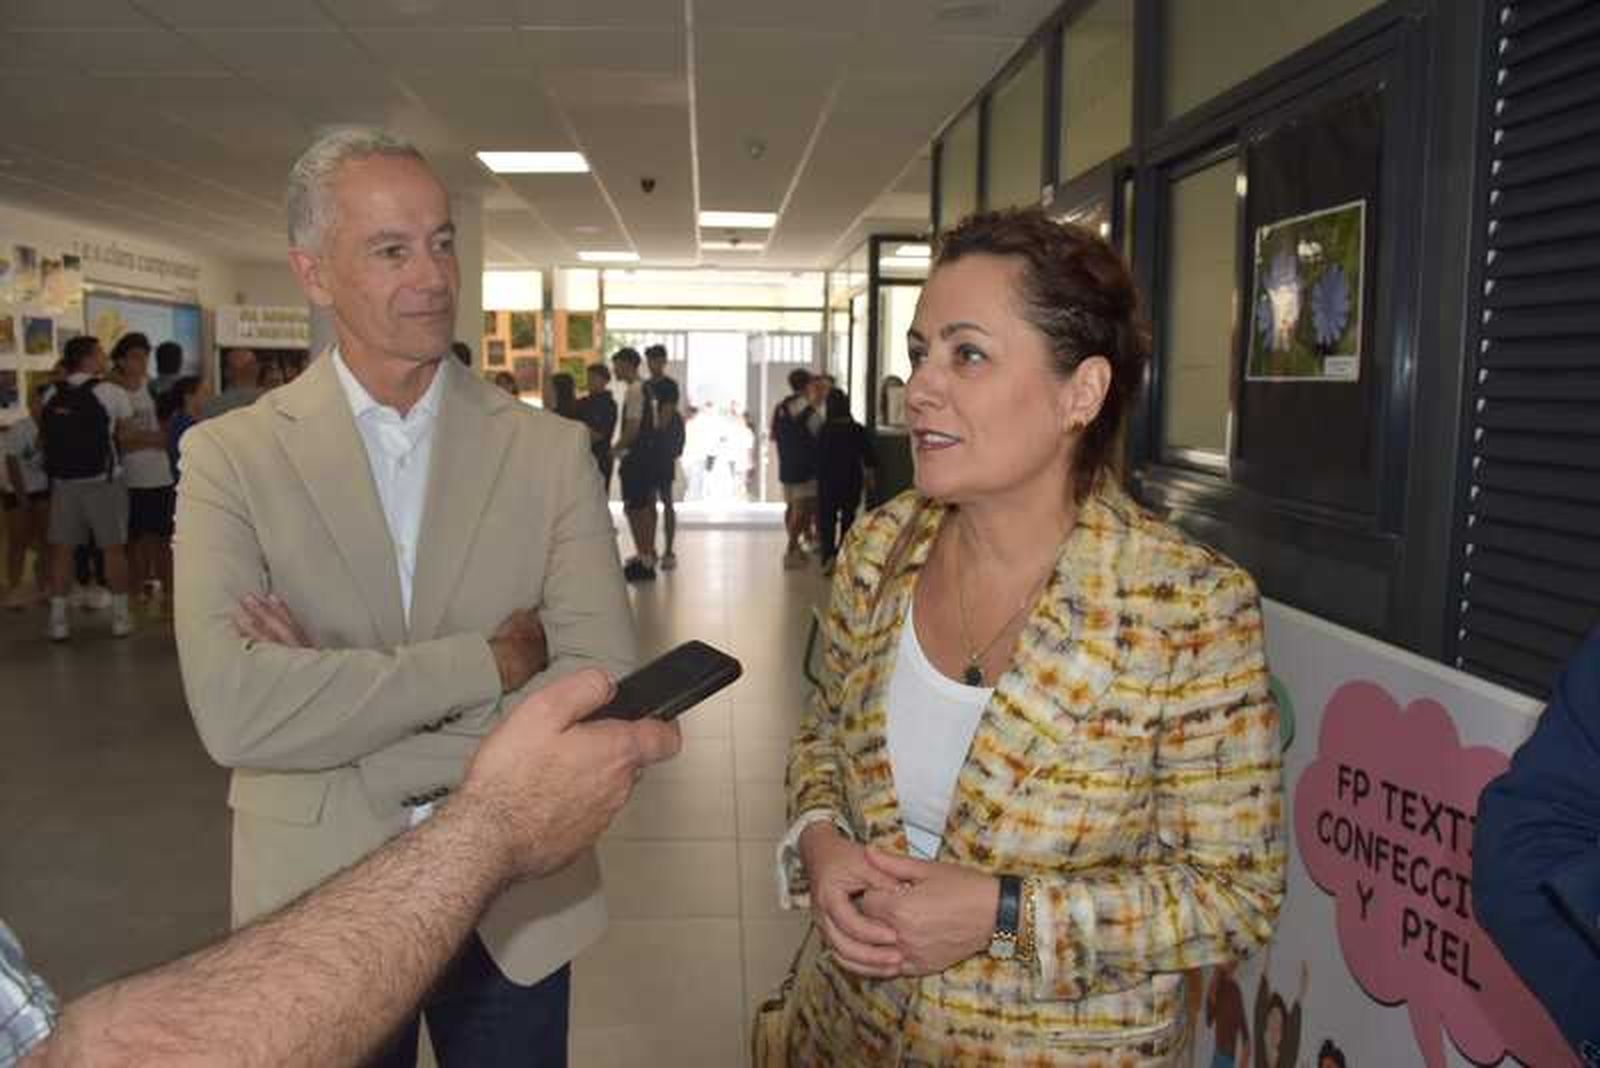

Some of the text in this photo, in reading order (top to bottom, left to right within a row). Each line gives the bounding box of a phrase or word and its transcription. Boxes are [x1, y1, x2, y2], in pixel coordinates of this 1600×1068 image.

[1338, 764, 1371, 807] FP
[1357, 879, 1482, 992] Y PIEL
